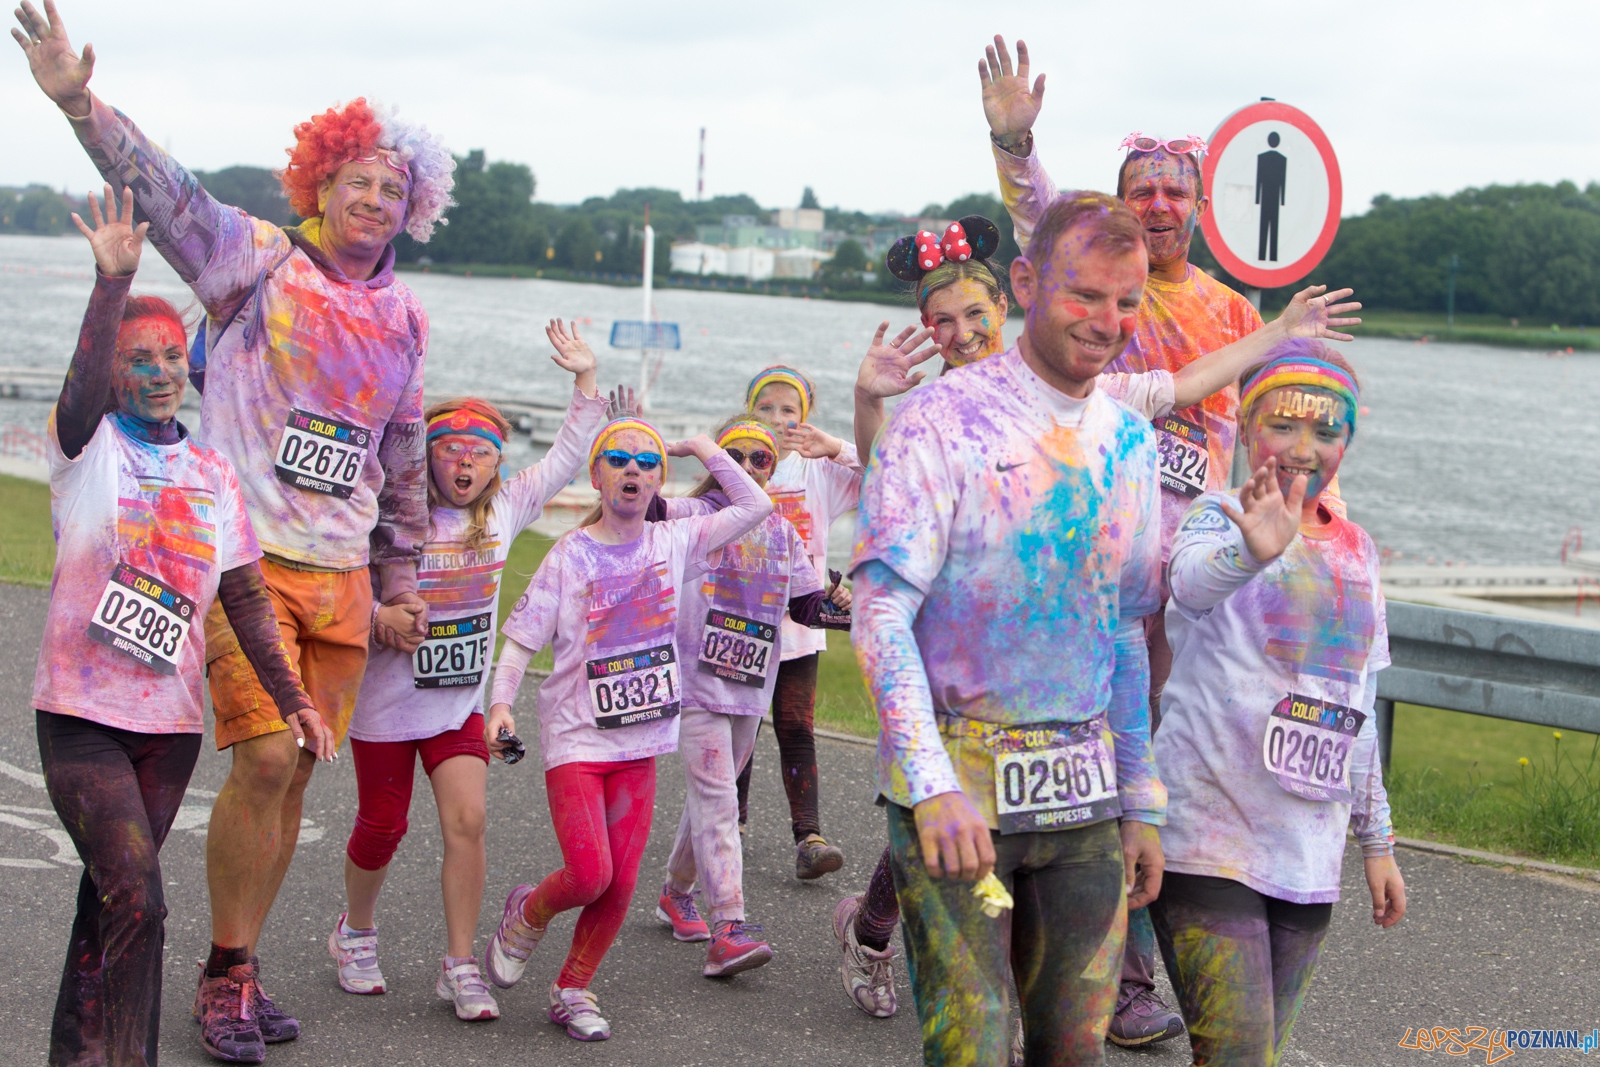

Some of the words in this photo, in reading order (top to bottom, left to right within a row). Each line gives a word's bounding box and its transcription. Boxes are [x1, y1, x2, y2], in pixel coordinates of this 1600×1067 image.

[1274, 391, 1339, 426] HAPPY
[293, 414, 311, 429] THE
[309, 419, 337, 437] COLOR
[335, 427, 351, 441] RUN
[1164, 419, 1190, 437] COLOR
[281, 434, 361, 482] 02676
[1159, 438, 1208, 486] 3324
[295, 475, 335, 493] #HAPPIEST5K
[1160, 473, 1188, 493] APPIEST5K
[421, 554, 441, 570] THE
[443, 551, 477, 569] COLOR
[118, 569, 137, 587] THE
[134, 576, 163, 600] COLOR
[159, 589, 175, 608] RUN
[100, 590, 182, 657] 02983
[431, 624, 458, 637] COLOR
[458, 622, 474, 634] RUN
[712, 613, 725, 626] THE
[724, 617, 747, 631] COLOR
[113, 637, 154, 664] #HAPPIEST5K
[417, 637, 488, 674] 02675
[704, 631, 768, 673] 02984
[592, 663, 607, 676] THE
[608, 658, 635, 673] COLOR
[634, 654, 652, 668] RUN
[438, 674, 479, 686] #HAPPIEST5K
[595, 669, 674, 713] 03321
[620, 708, 662, 725] #HAPPIEST5K
[1291, 701, 1320, 722] COLOR
[1268, 726, 1348, 784] 02963
[1003, 749, 1107, 806] 02961
[1034, 806, 1093, 826] #HAPPIEST5K
